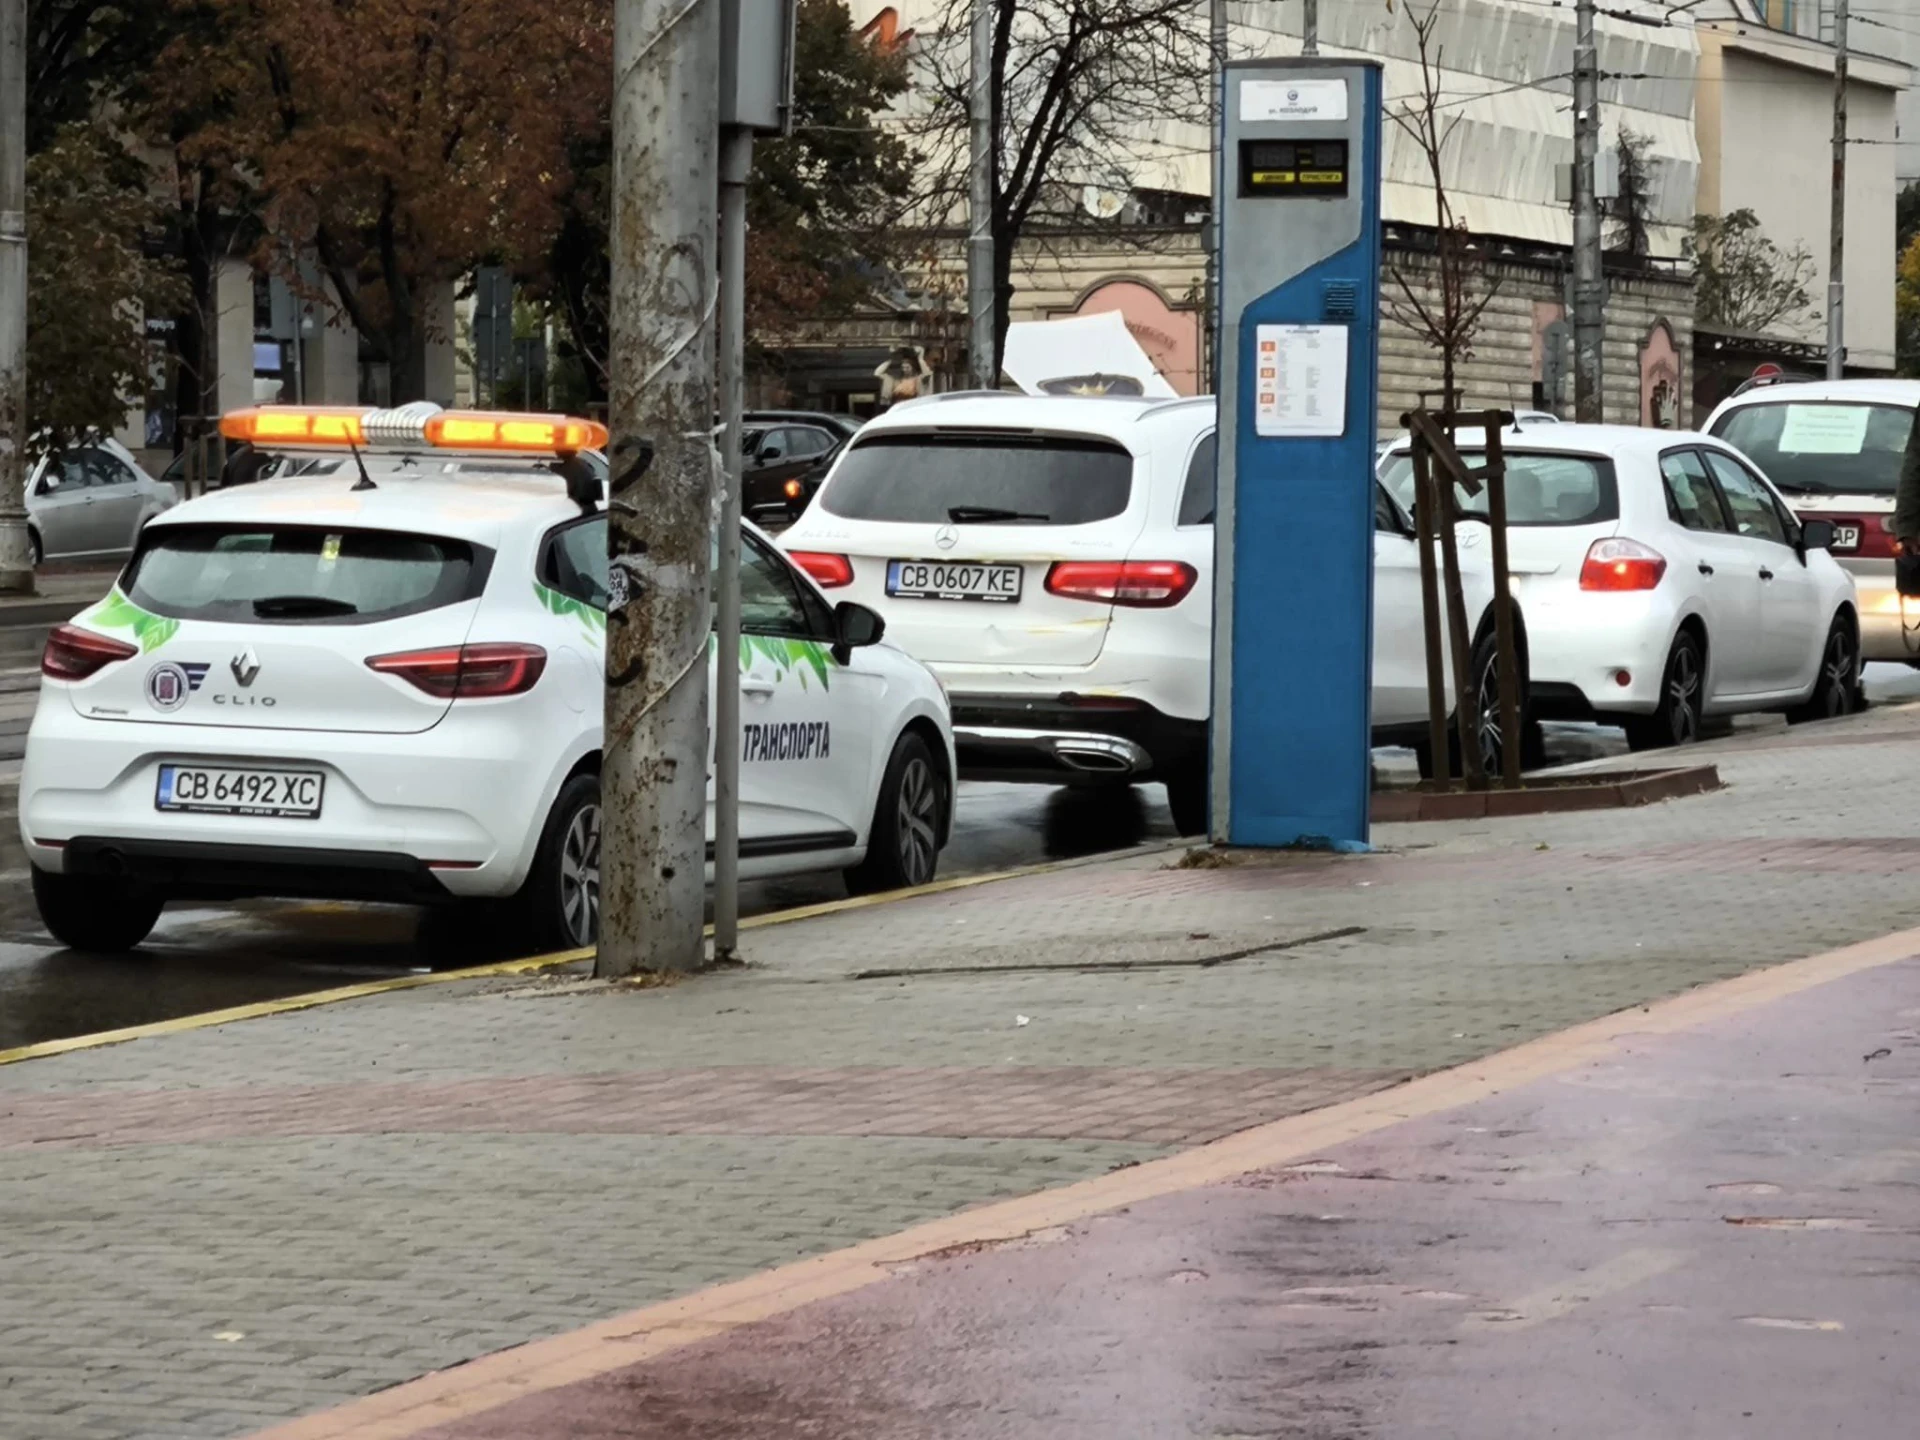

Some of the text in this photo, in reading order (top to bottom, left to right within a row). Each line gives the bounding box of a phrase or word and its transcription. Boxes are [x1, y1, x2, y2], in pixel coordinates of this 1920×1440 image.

[902, 565, 1016, 592] CB 0607 KE
[212, 693, 277, 707] CLIO
[743, 721, 830, 762] ТРАНСПОРТА
[176, 771, 316, 805] CB 6492 XC
